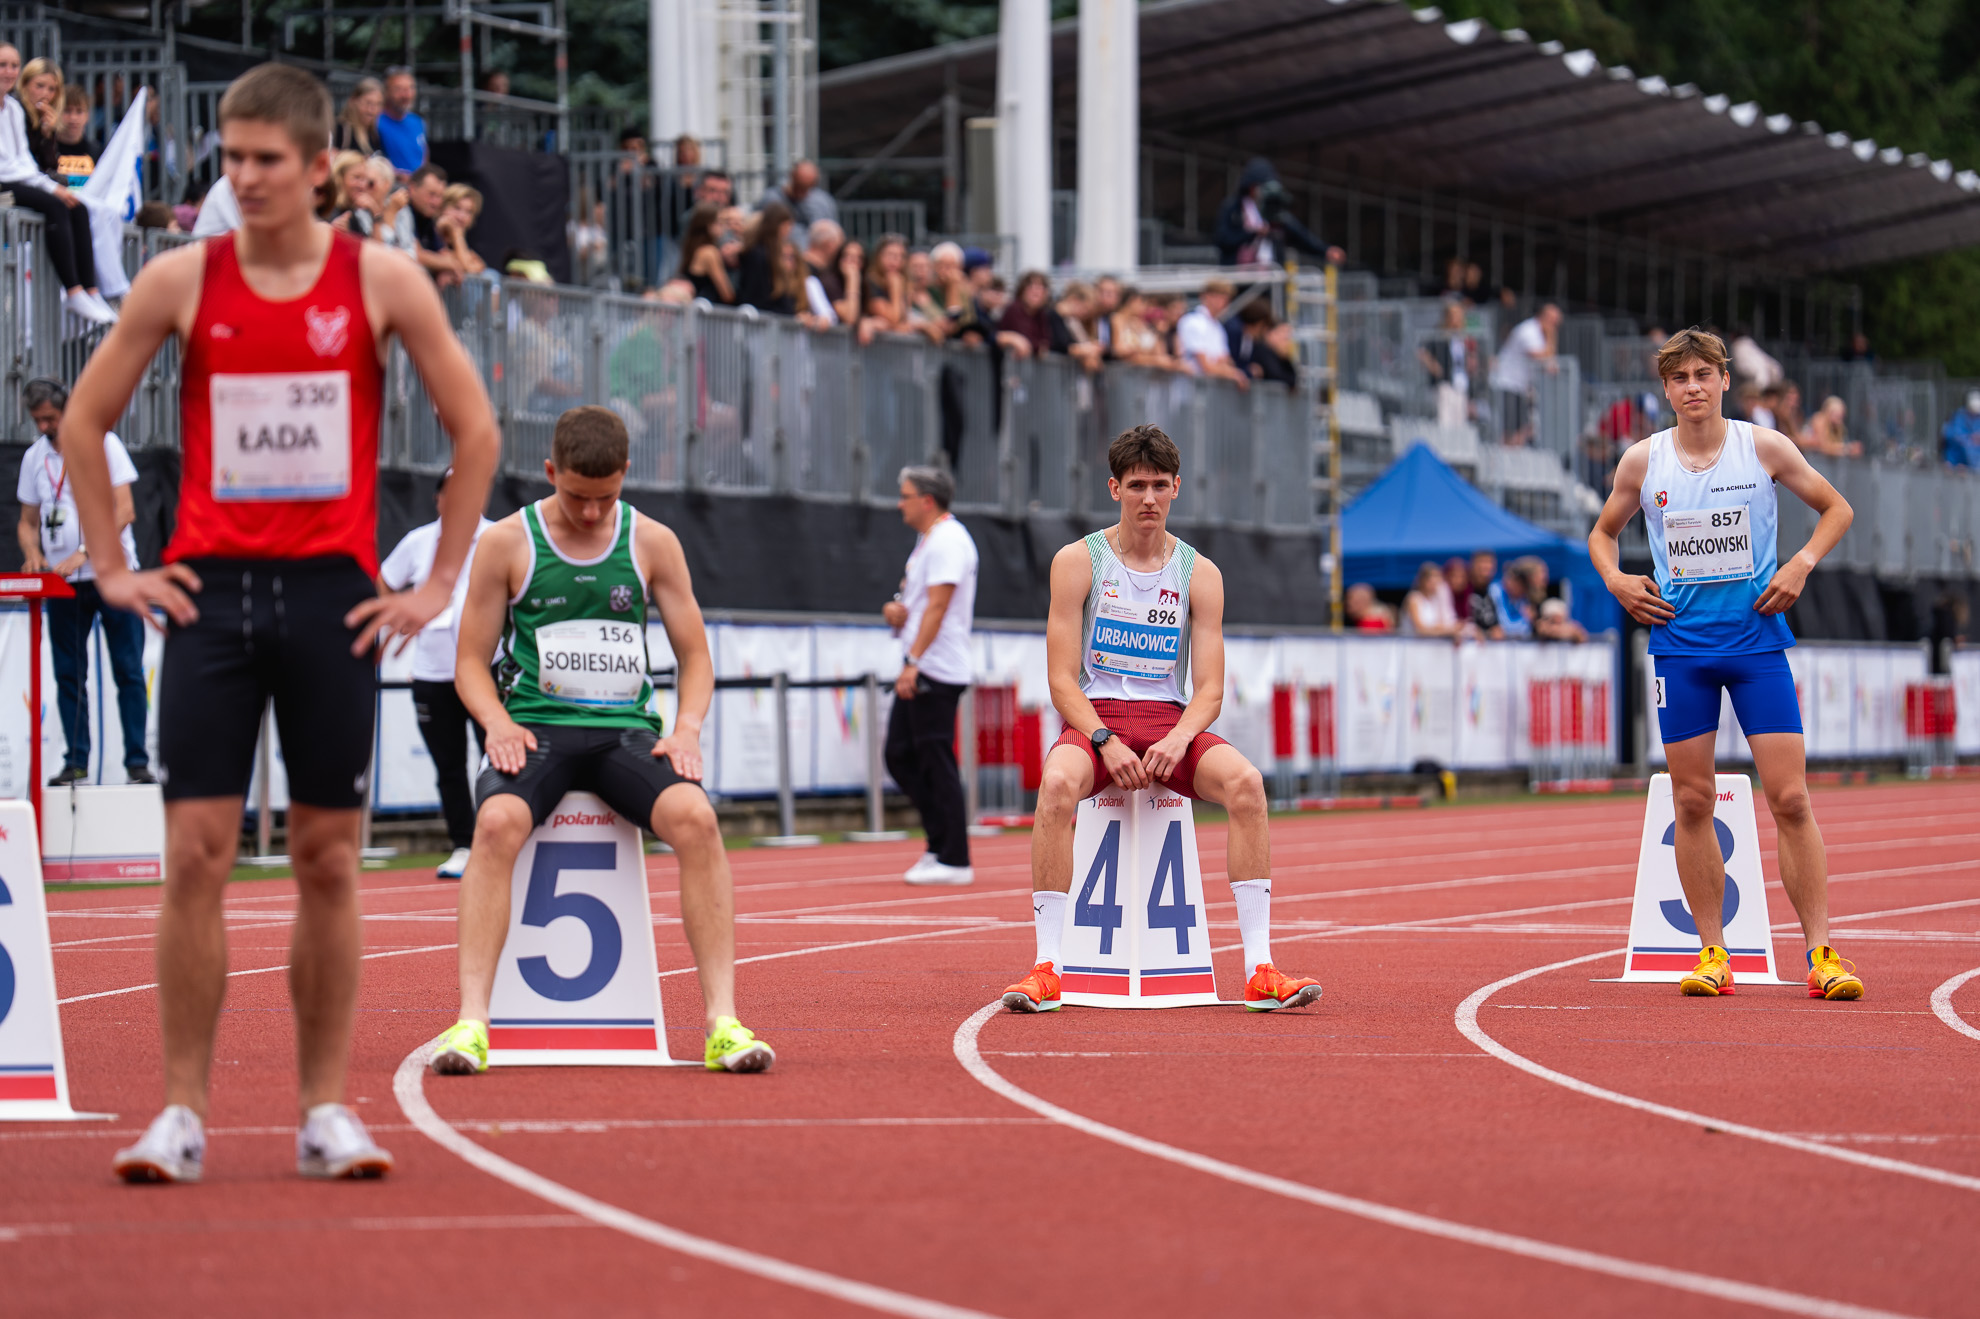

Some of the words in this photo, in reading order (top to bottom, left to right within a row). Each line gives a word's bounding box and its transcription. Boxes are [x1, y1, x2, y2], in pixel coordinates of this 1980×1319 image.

[288, 383, 338, 407] 330
[237, 423, 322, 453] ŁADA
[1726, 483, 1757, 492] ACHILLES
[1711, 510, 1742, 527] 857
[1668, 534, 1748, 557] MAĆKOWSKI
[1147, 608, 1177, 625] 896
[600, 625, 634, 643] 156
[1095, 625, 1178, 653] URBANOWICZ
[545, 651, 641, 674] SOBIESIAK
[1656, 679, 1662, 705] 3
[1097, 795, 1126, 809] polanik
[1156, 795, 1184, 810] polanik
[552, 811, 617, 828] polanik
[1074, 820, 1123, 955] 4
[1147, 820, 1197, 955] 4
[516, 841, 623, 1002] 5
